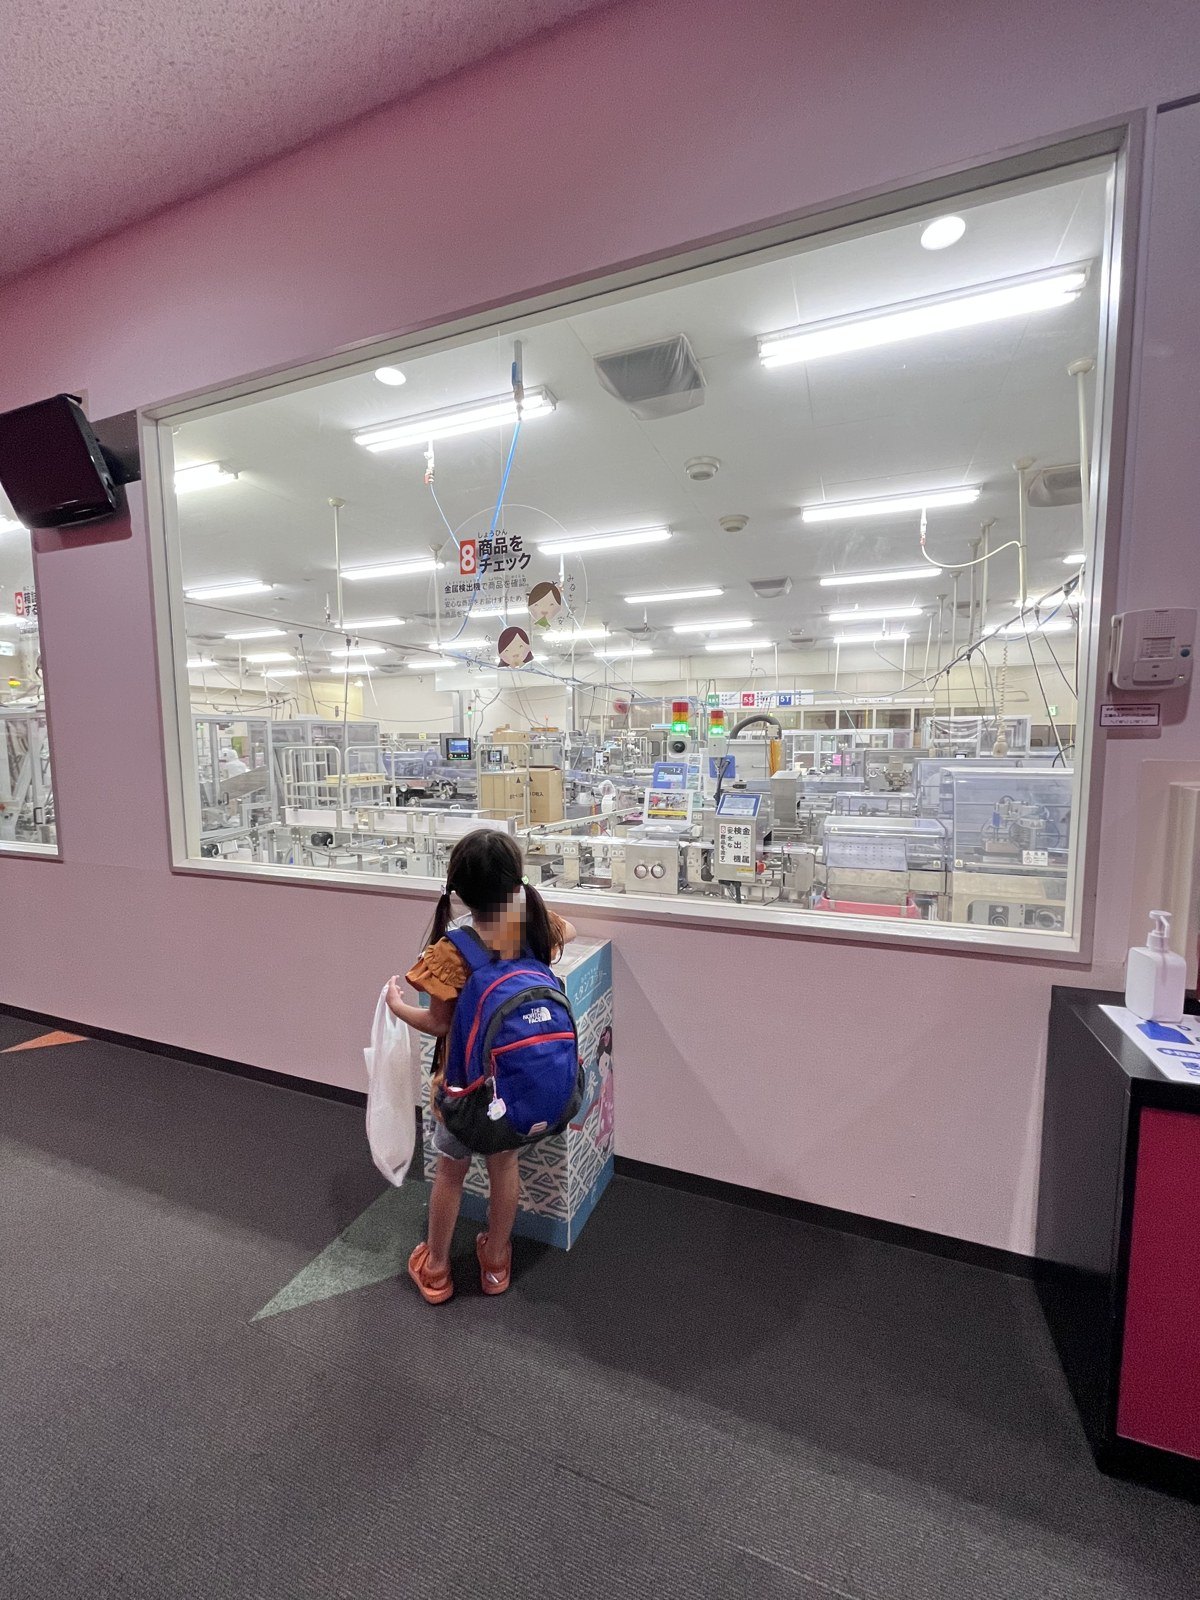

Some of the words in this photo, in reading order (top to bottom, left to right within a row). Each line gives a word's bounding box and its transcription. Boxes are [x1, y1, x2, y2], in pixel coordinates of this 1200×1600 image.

[478, 535, 524, 557] 商品を
[461, 544, 475, 572] 8
[479, 552, 532, 574] チェック
[780, 695, 791, 703] 5T
[522, 1012, 542, 1021] NORTH
